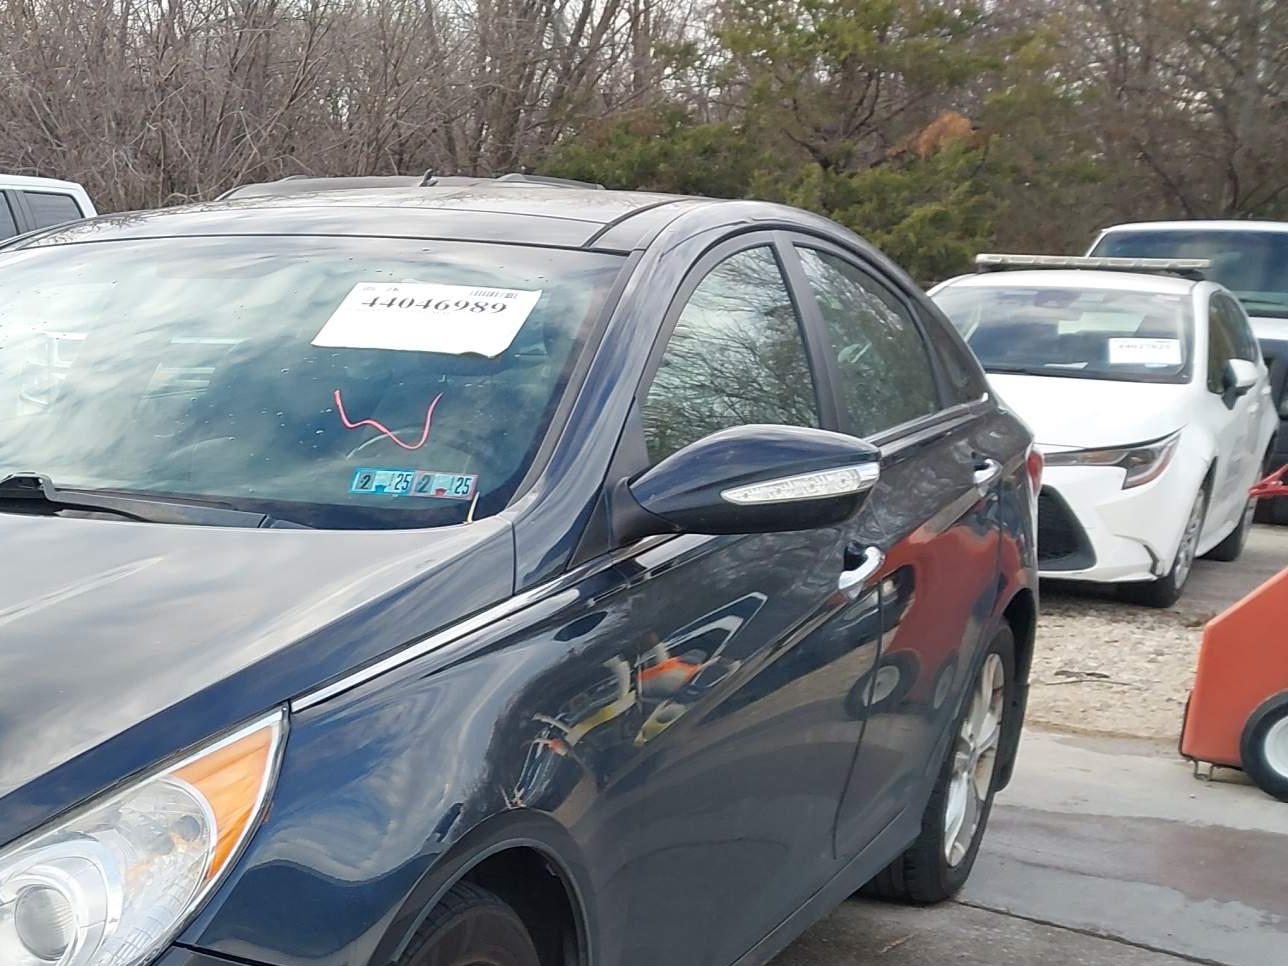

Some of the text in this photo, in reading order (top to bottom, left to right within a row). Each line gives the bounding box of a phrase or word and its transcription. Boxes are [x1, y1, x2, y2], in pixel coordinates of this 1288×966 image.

[361, 296, 508, 314] 44046989
[394, 473, 413, 491] 25
[454, 476, 473, 495] 25
